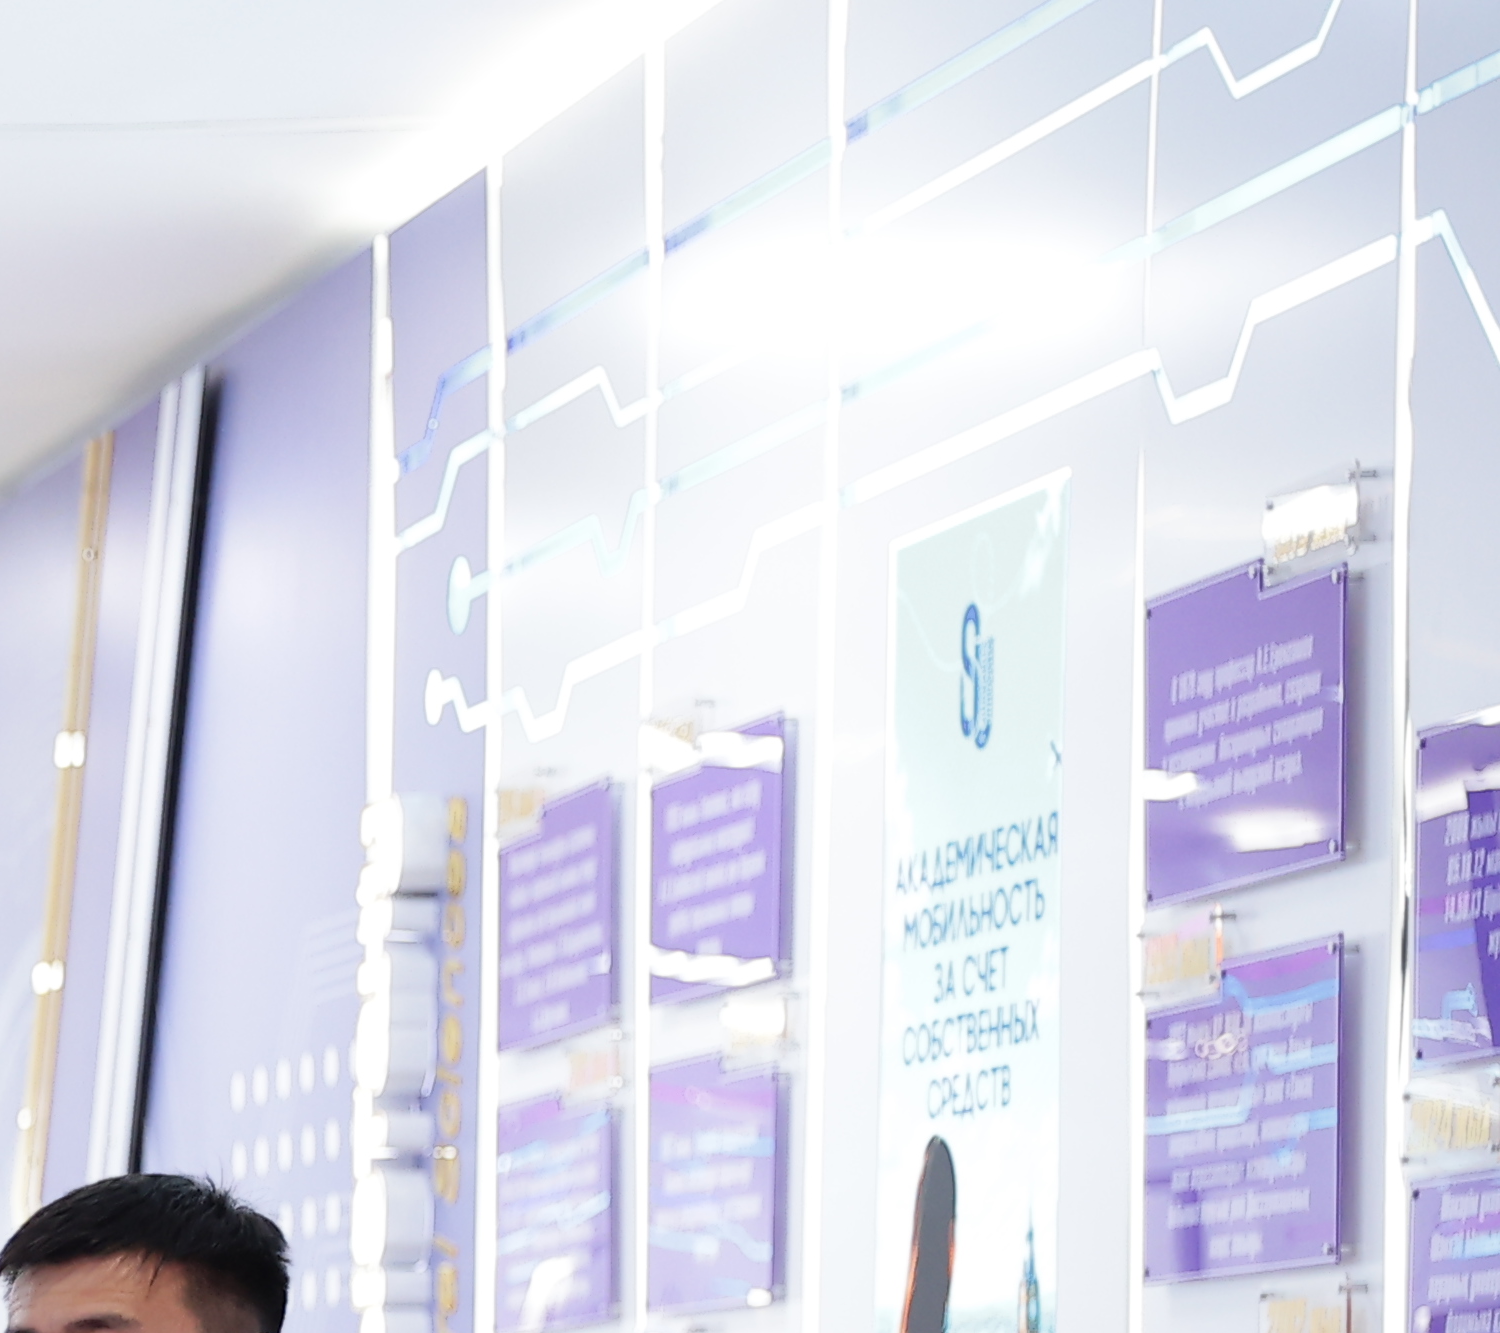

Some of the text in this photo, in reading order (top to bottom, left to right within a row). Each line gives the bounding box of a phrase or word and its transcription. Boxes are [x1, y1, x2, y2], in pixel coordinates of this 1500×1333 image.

[895, 809, 1059, 895] АКАДЕМИЧЕСКАЯ
[903, 877, 1045, 952] МОБИЛЬНОСТЬ
[933, 945, 1009, 1003] ЗА СЧЕТ
[902, 998, 1040, 1066] СОБСТВЕННЫХ
[927, 1063, 1012, 1120] СРЕДСТВ
